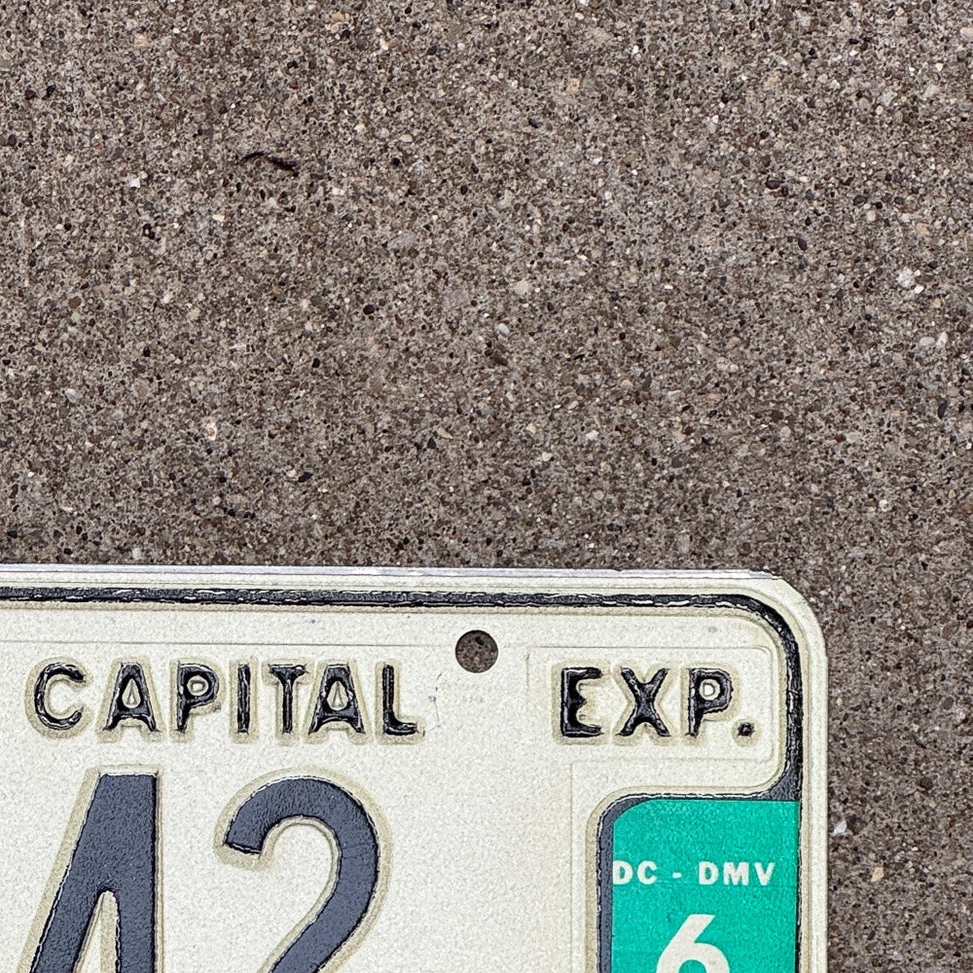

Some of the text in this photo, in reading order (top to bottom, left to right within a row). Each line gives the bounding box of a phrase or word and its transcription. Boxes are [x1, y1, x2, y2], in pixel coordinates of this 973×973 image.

[33, 662, 419, 736] CAPITAL
[559, 667, 755, 738] EXP.
[612, 860, 657, 886] DC
[698, 861, 775, 886] DMV
